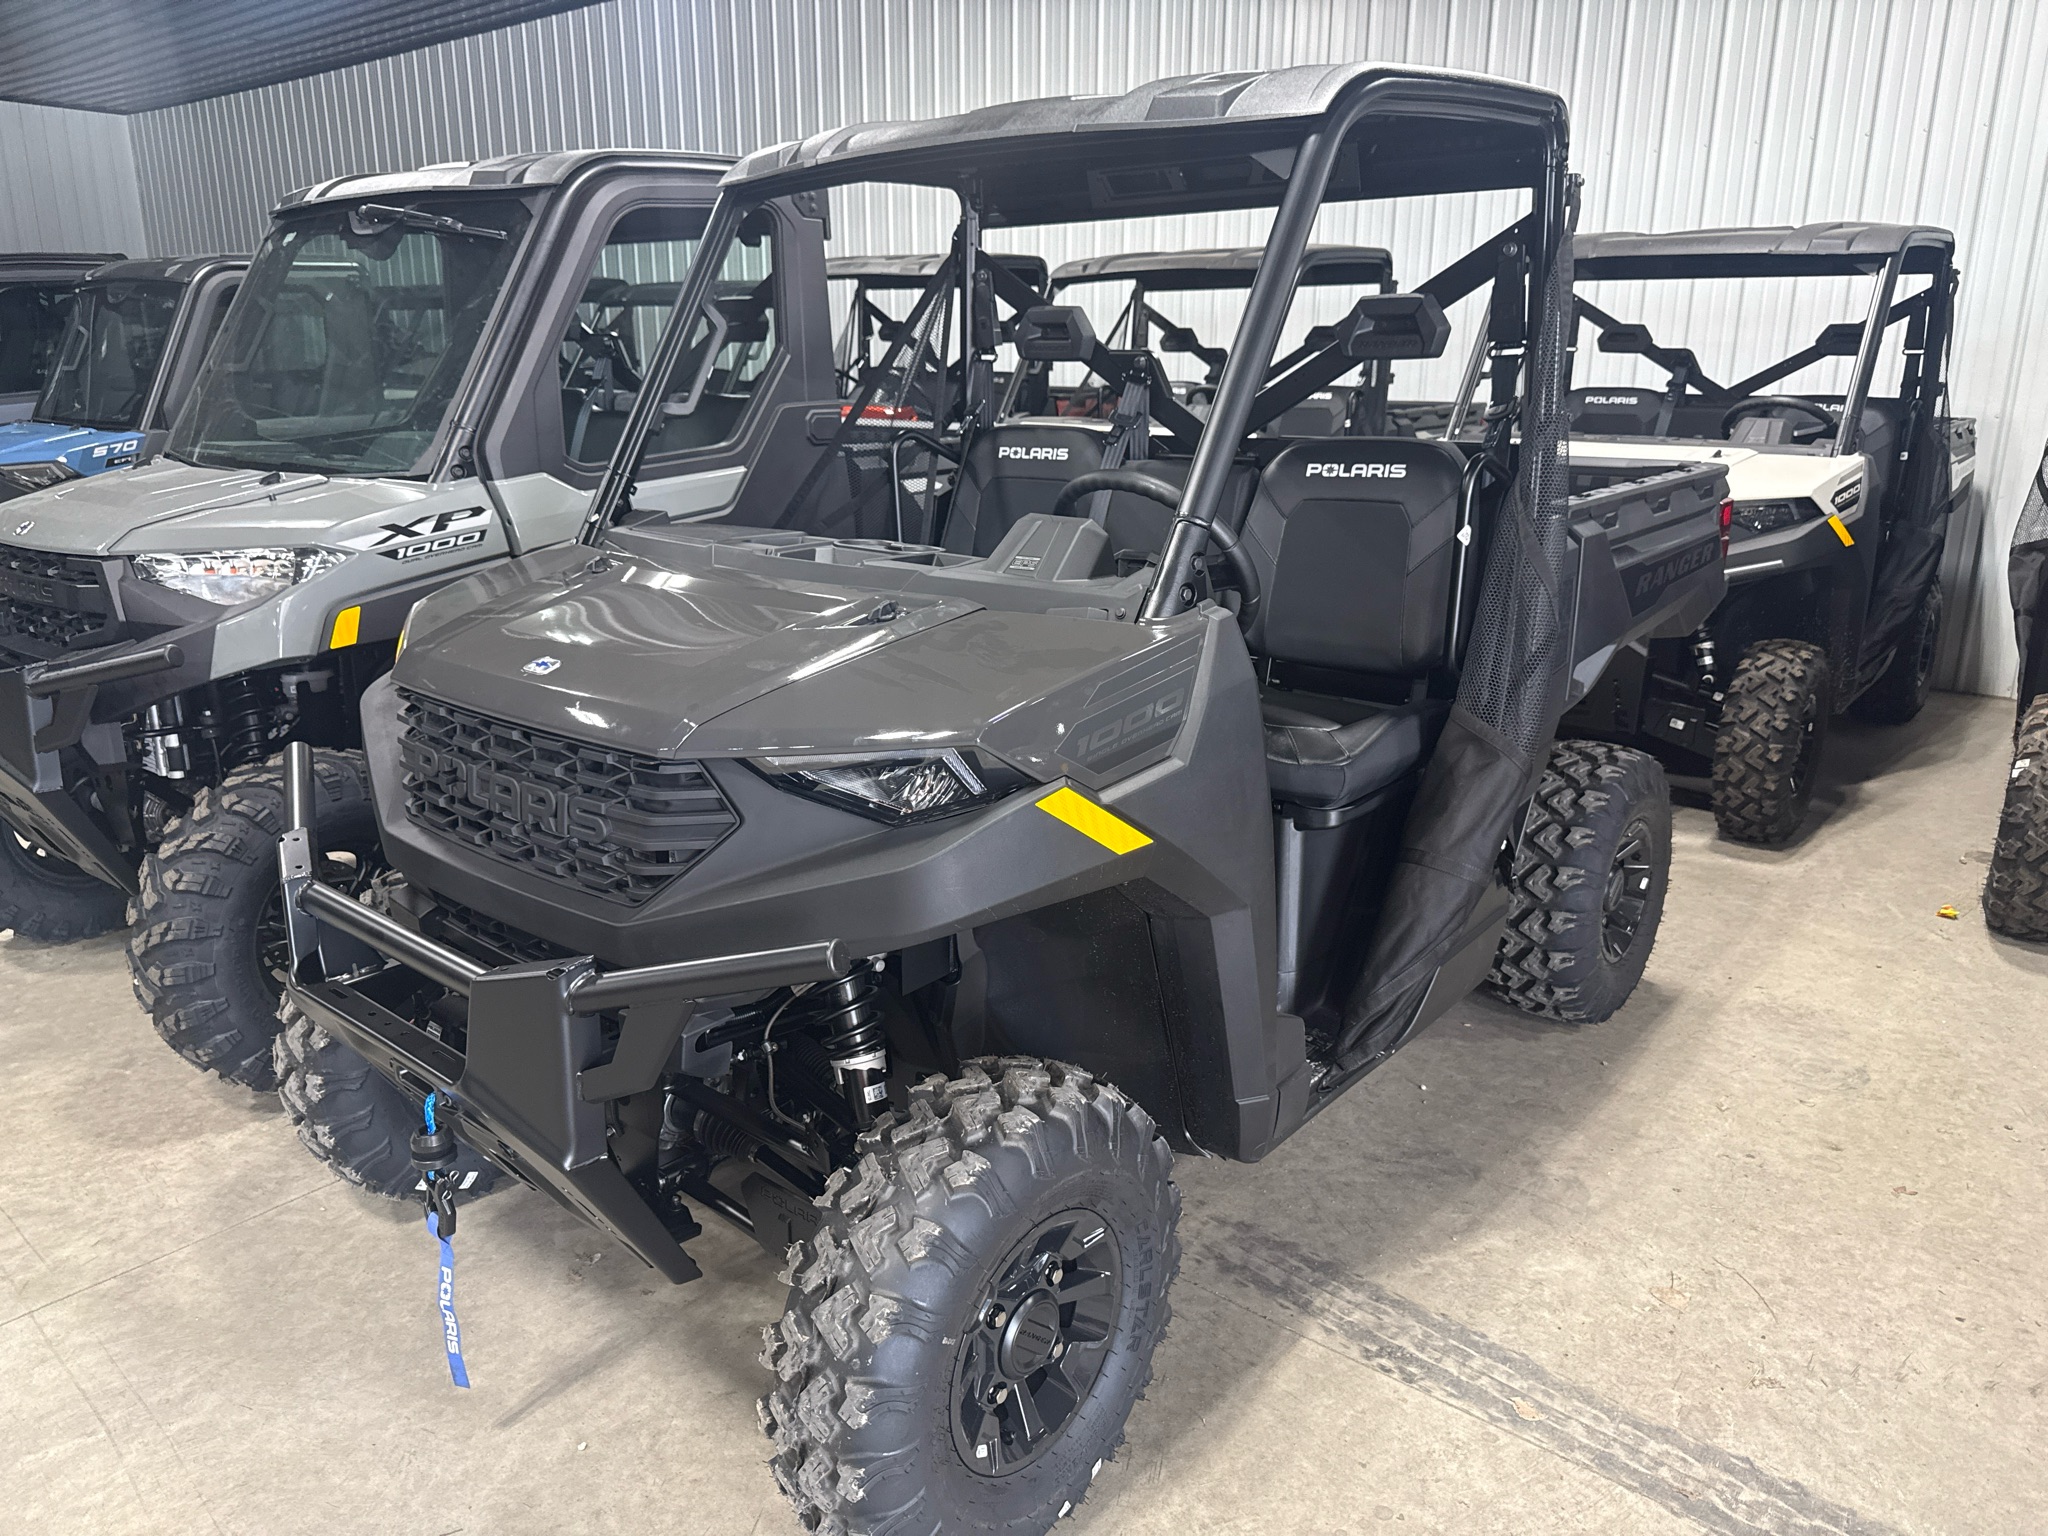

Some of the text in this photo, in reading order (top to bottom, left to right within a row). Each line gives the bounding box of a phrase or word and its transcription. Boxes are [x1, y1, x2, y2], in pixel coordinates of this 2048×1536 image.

[1584, 395, 1638, 405] POLARIS
[92, 439, 138, 458] 570
[998, 446, 1069, 460] POLARIS
[1305, 463, 1407, 478] POLARIS
[1834, 483, 1861, 505] 1000
[367, 505, 487, 549] XP
[396, 531, 481, 559] 1000
[1634, 542, 1715, 598] RANGER
[1076, 687, 1185, 758] 1000
[1121, 719, 1165, 746] OVERHEAD
[400, 736, 613, 845] POLARIS
[760, 1184, 819, 1227] POLAR
[1126, 1218, 1154, 1353] CARLSTAR
[439, 1265, 460, 1355] POLARIS
